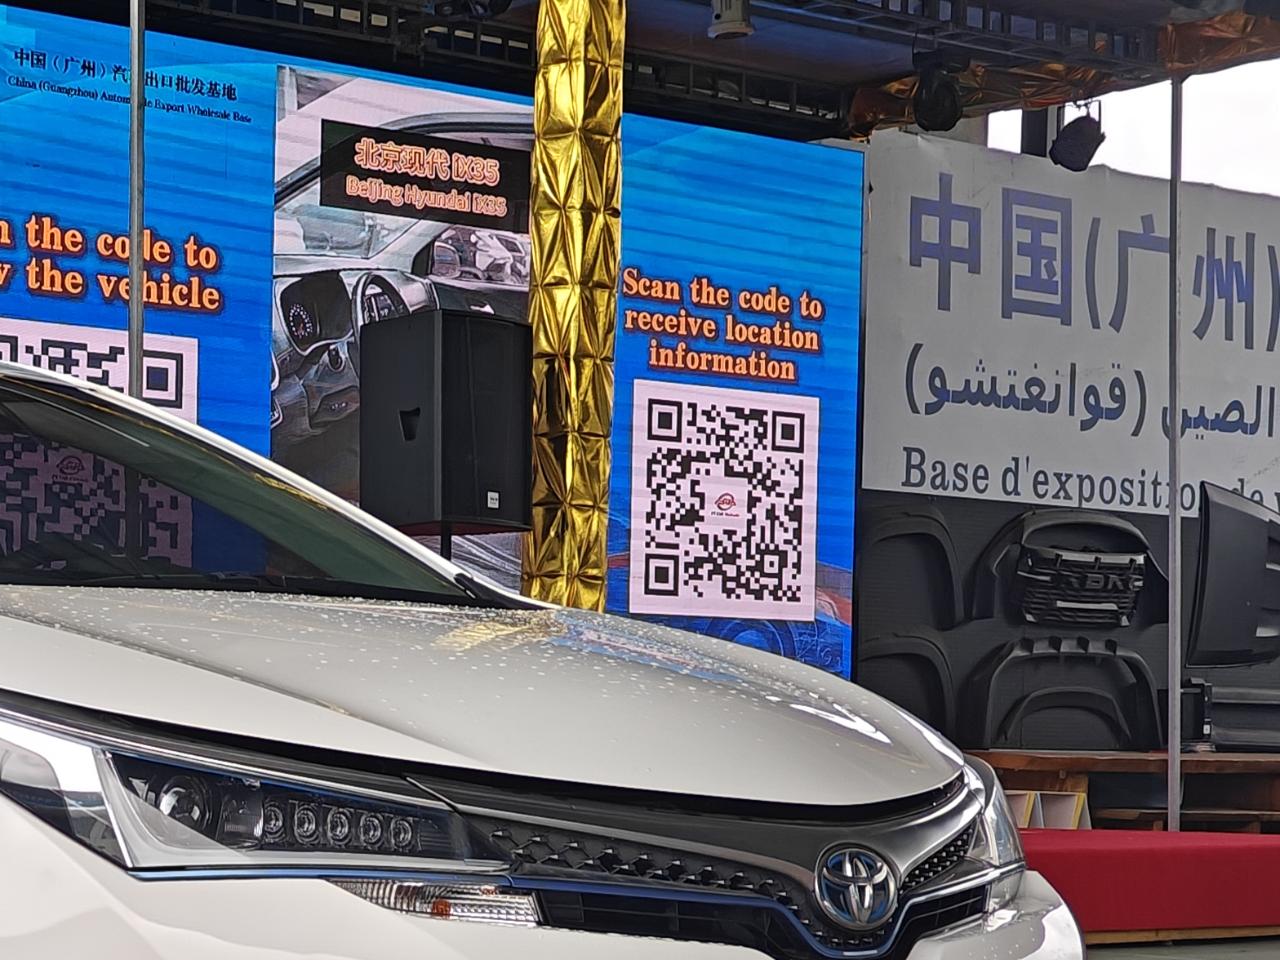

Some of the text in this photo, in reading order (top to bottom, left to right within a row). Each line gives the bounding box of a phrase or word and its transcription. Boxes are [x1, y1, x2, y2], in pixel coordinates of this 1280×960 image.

[7, 75, 252, 123] China (Guangzhou) Automle Export Wholesale Base
[354, 138, 450, 181] 北京现代
[346, 175, 404, 206] Beijing
[404, 184, 470, 212] Hyundai
[26, 214, 83, 252] the
[184, 235, 217, 269] to
[26, 257, 83, 294] the
[96, 270, 220, 310] vehicle
[623, 267, 822, 318] Scan the code to
[624, 309, 819, 350] receive location
[649, 339, 795, 380] information
[901, 446, 990, 496] Base
